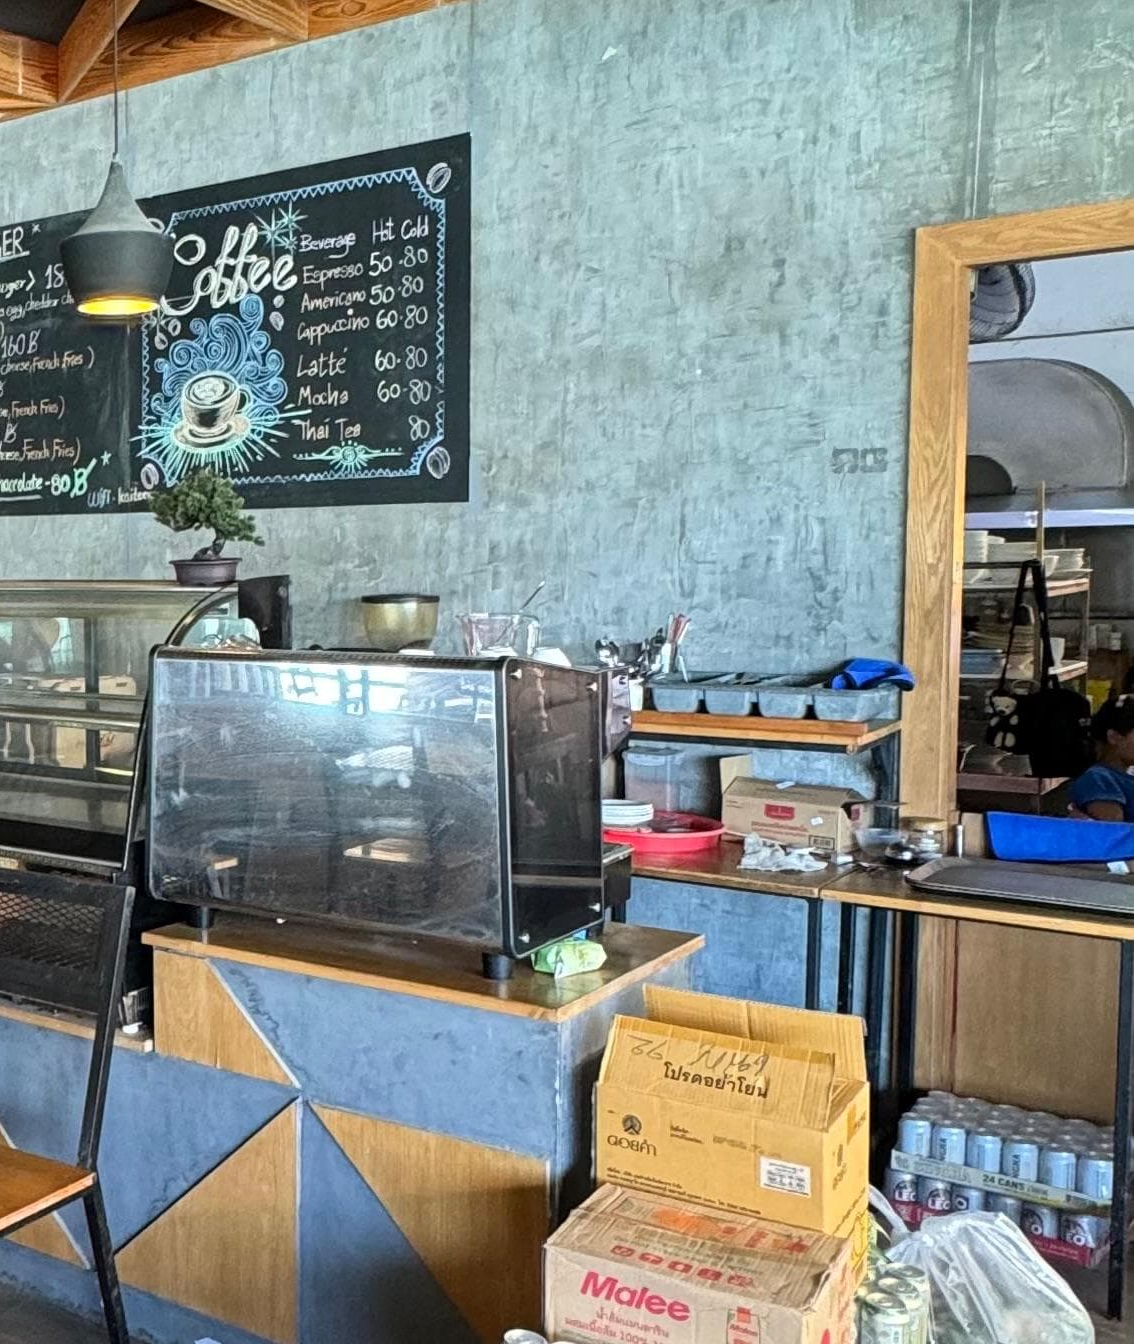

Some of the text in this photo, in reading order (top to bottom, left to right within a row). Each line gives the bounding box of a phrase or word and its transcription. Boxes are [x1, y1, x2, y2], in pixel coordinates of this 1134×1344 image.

[372, 215, 429, 244] Hot Cold
[299, 232, 356, 258] Beverage
[45, 263, 66, 289] 18
[160, 222, 298, 316] Coffee
[303, 263, 364, 291] Espresso
[368, 252, 393, 276] 50
[300, 290, 366, 313] Americano
[369, 284, 395, 305] 50
[297, 308, 370, 345] Cappuccino
[376, 309, 398, 329] 60
[375, 349, 396, 371] 60
[298, 382, 349, 406] Mocha
[377, 380, 400, 403] 60
[296, 415, 431, 441] Thai Tea 80
[983, 1174, 996, 1184] 24
[997, 1177, 1026, 1192] CANS
[580, 1270, 691, 1322] Malee
